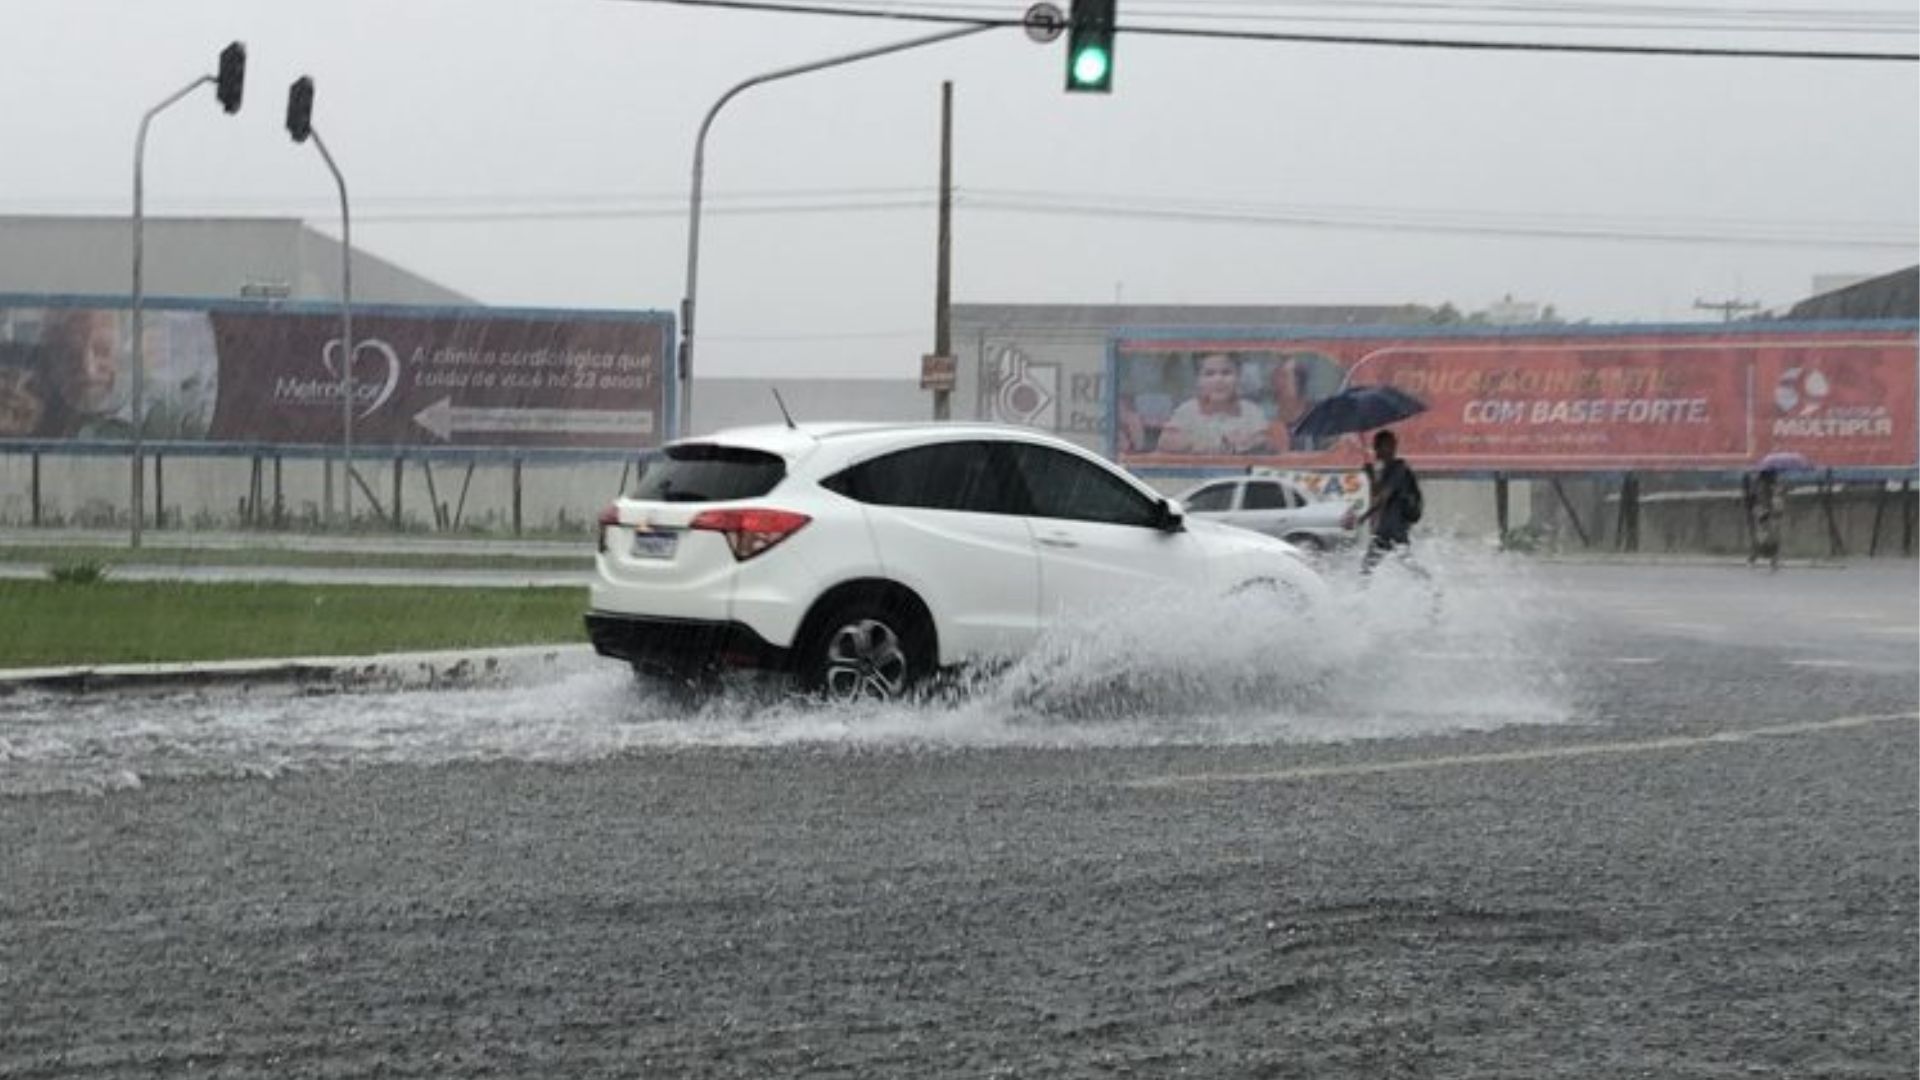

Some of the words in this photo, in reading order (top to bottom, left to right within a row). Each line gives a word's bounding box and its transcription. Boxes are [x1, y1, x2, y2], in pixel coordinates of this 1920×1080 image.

[617, 352, 652, 371] que
[1464, 399, 1525, 425] COM
[1530, 399, 1604, 424] BASE
[1611, 398, 1710, 424] FORTE.
